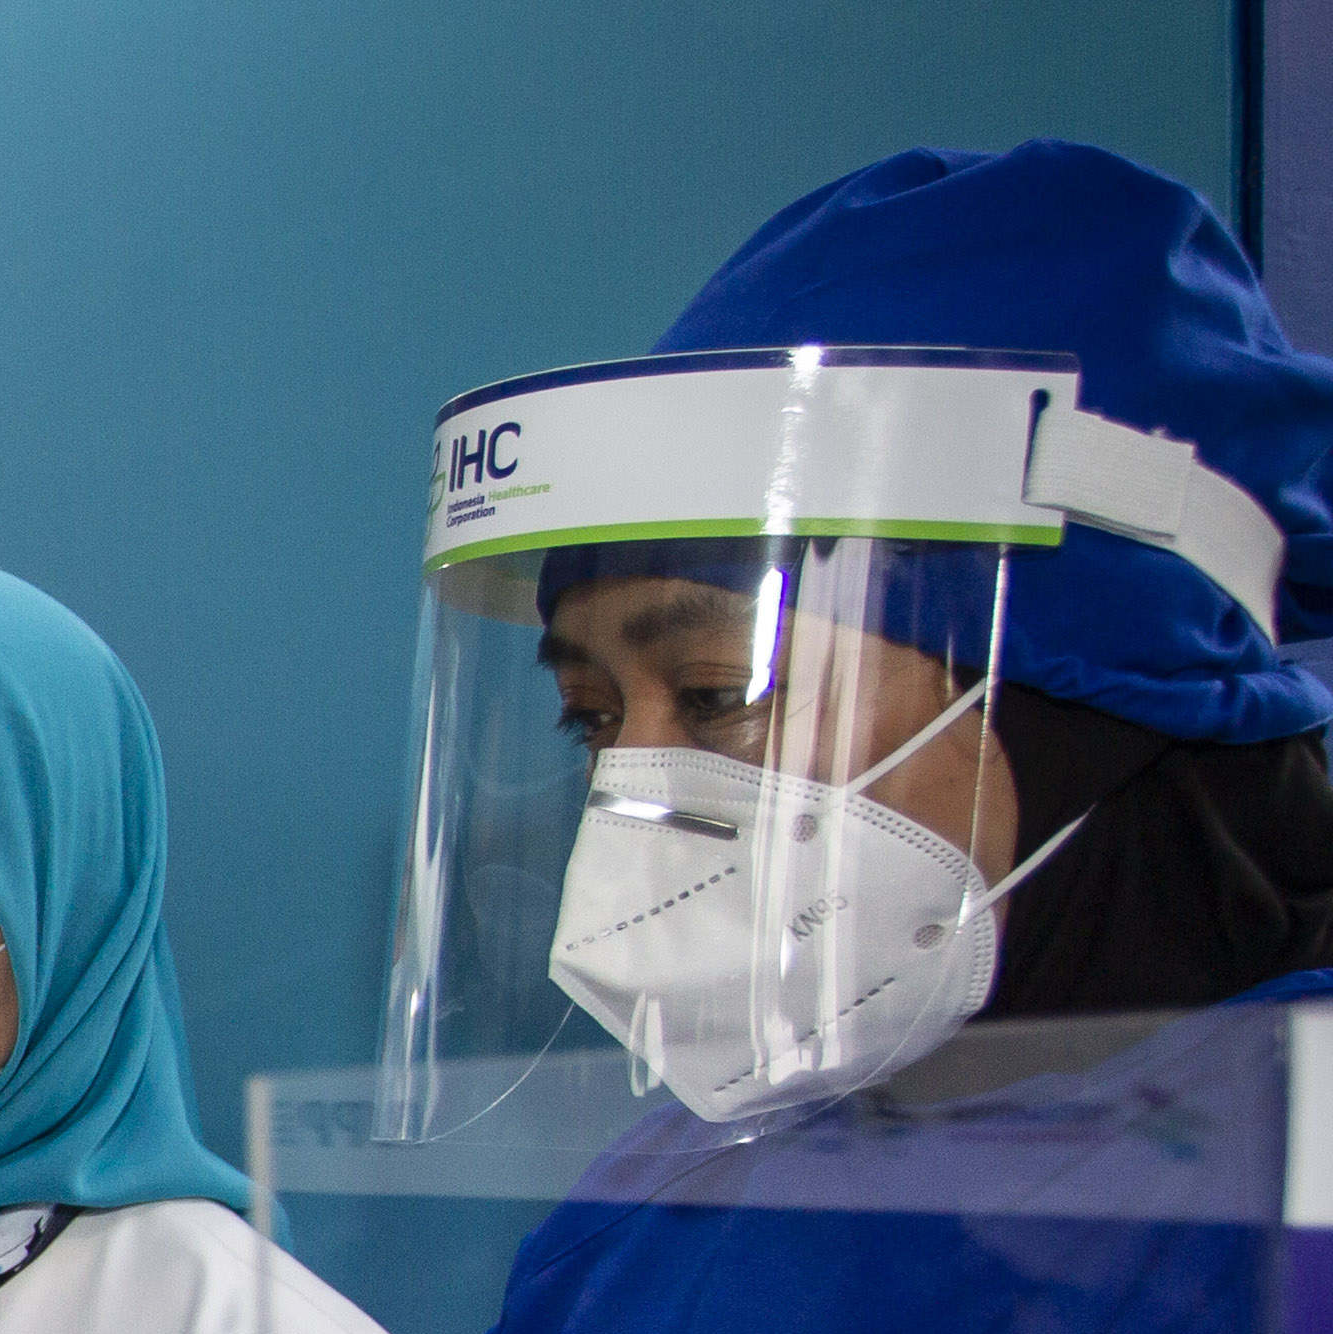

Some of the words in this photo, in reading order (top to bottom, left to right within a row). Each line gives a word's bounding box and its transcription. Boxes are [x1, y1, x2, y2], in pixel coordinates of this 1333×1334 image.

[449, 421, 521, 492] IHC
[447, 494, 485, 515] Indonesia
[487, 483, 551, 503] Healthcare
[446, 506, 496, 528] Corporation
